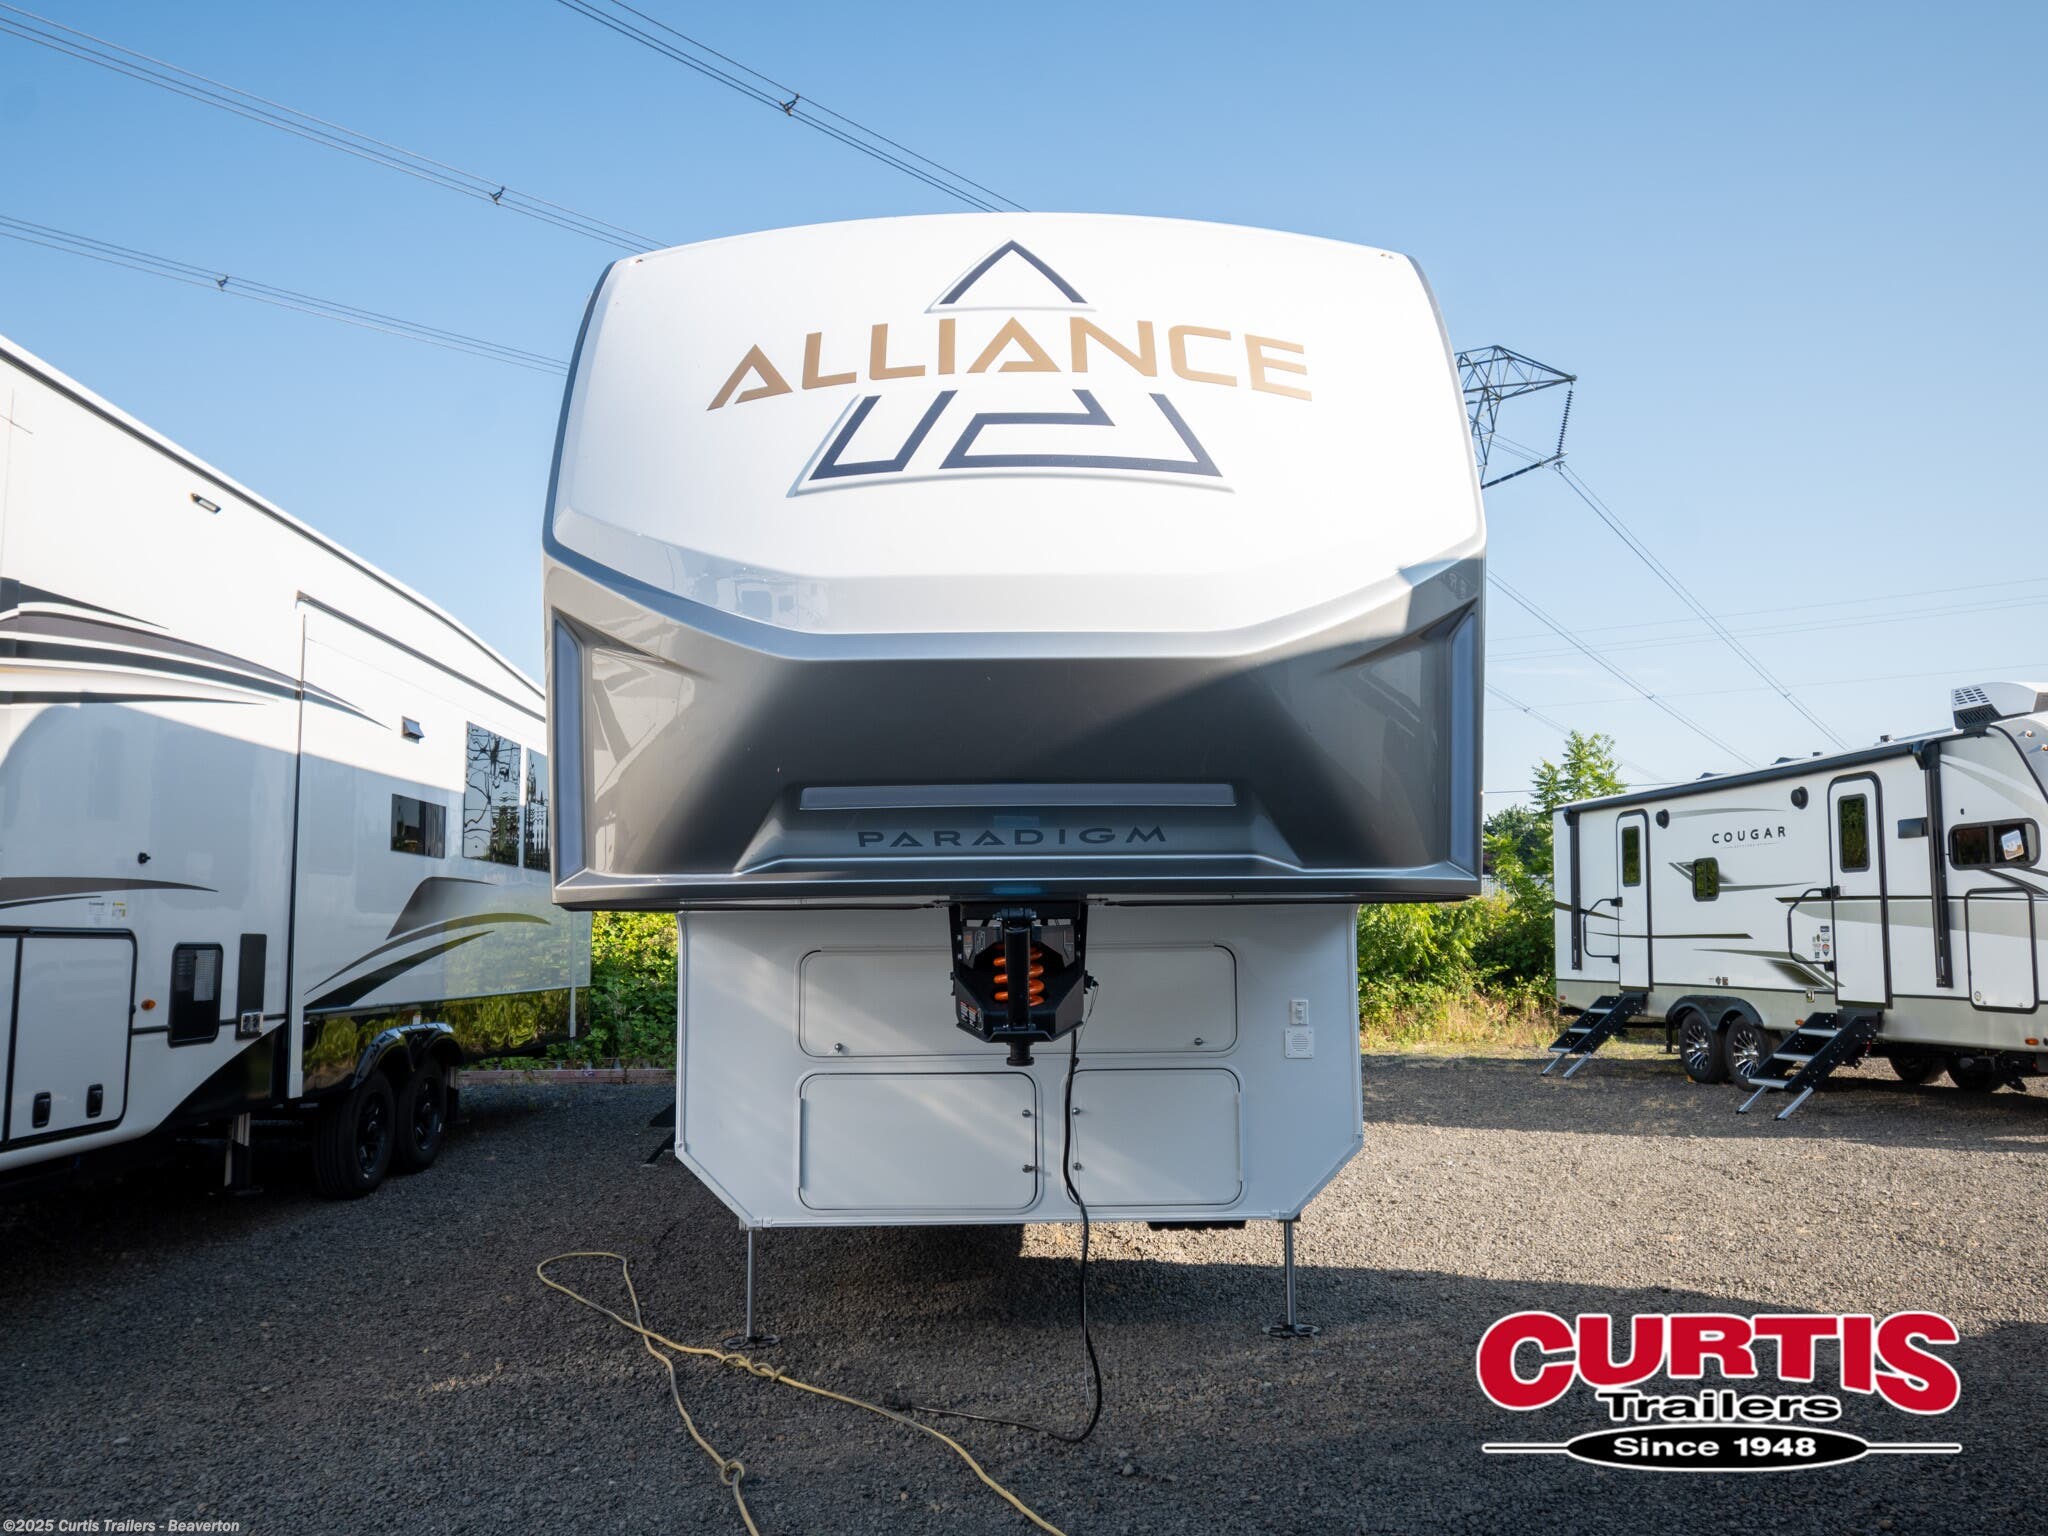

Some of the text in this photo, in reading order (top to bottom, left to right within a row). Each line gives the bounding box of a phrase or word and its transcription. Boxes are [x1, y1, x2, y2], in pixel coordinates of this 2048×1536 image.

[706, 316, 1313, 412] ALLIANCE
[857, 825, 1167, 848] PARADIGM
[1711, 826, 1786, 844] COUGAR
